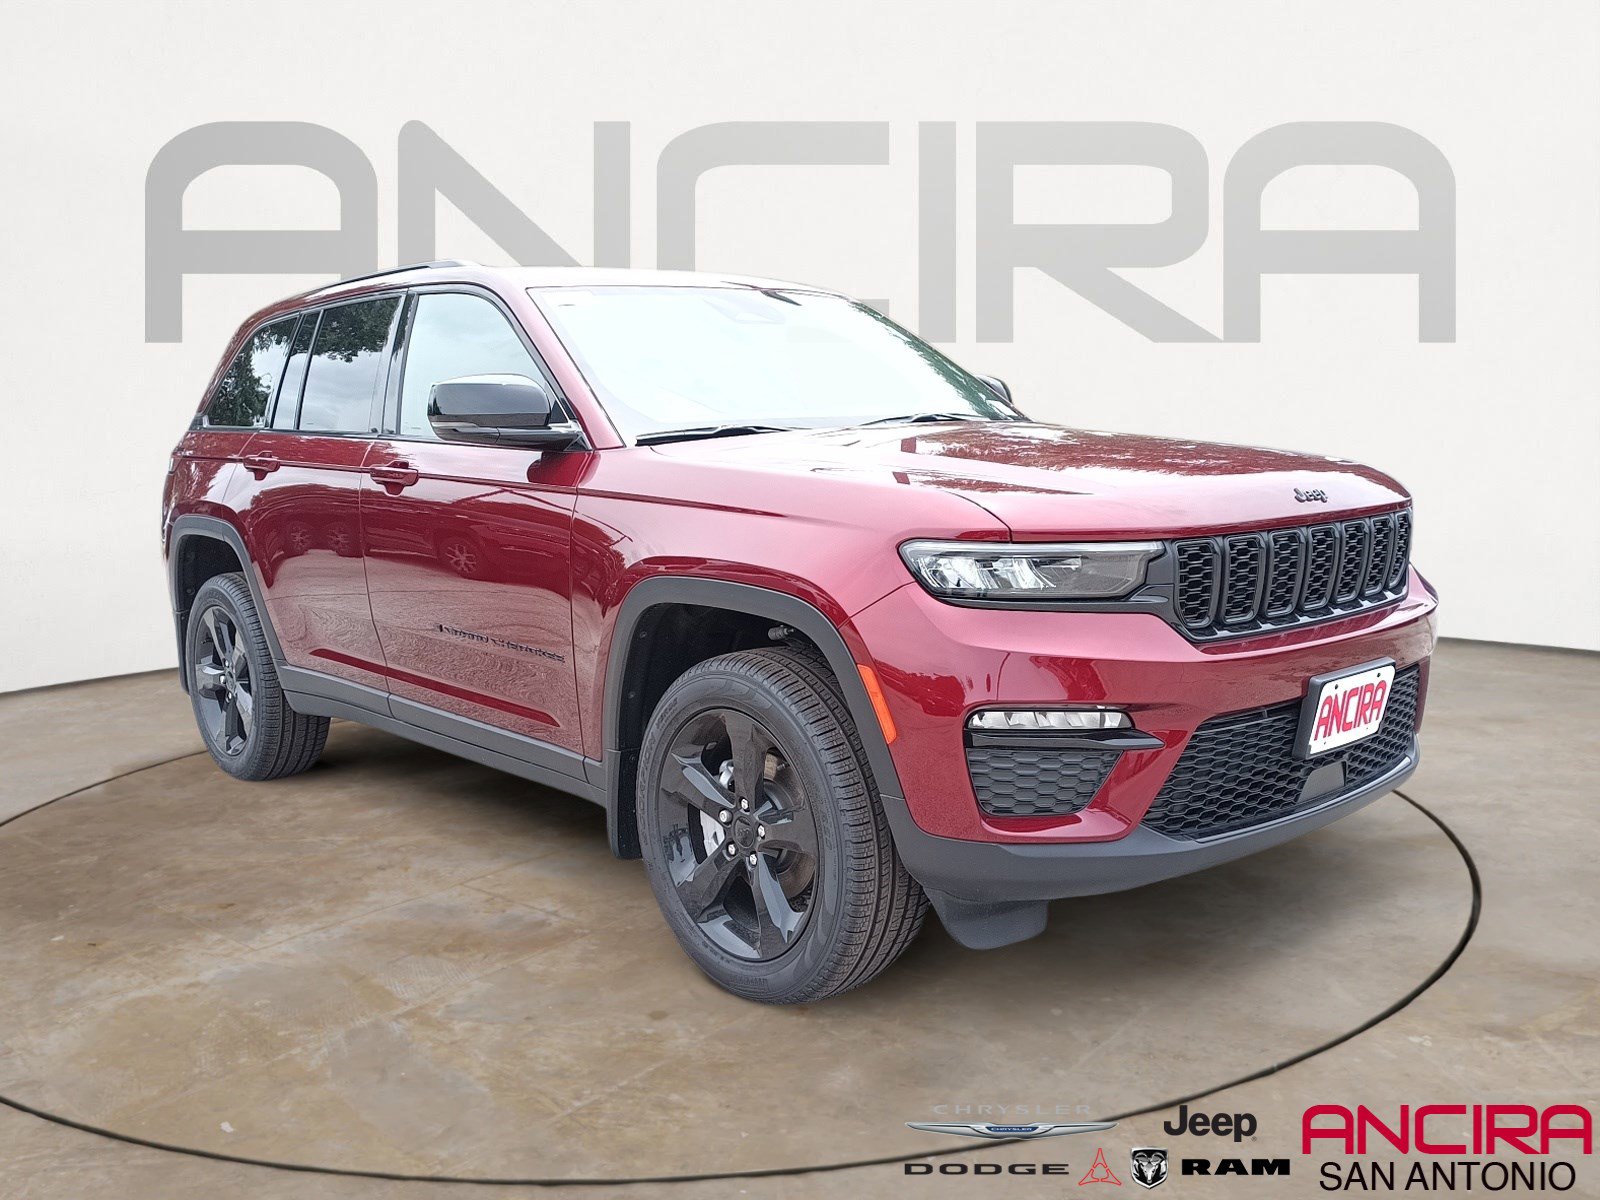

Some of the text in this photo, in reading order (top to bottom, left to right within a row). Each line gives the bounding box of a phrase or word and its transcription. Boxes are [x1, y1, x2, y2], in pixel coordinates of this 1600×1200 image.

[145, 119, 1457, 344] ANCIRA
[1293, 487, 1328, 503] Jeep
[1313, 680, 1387, 741] ANCIRA
